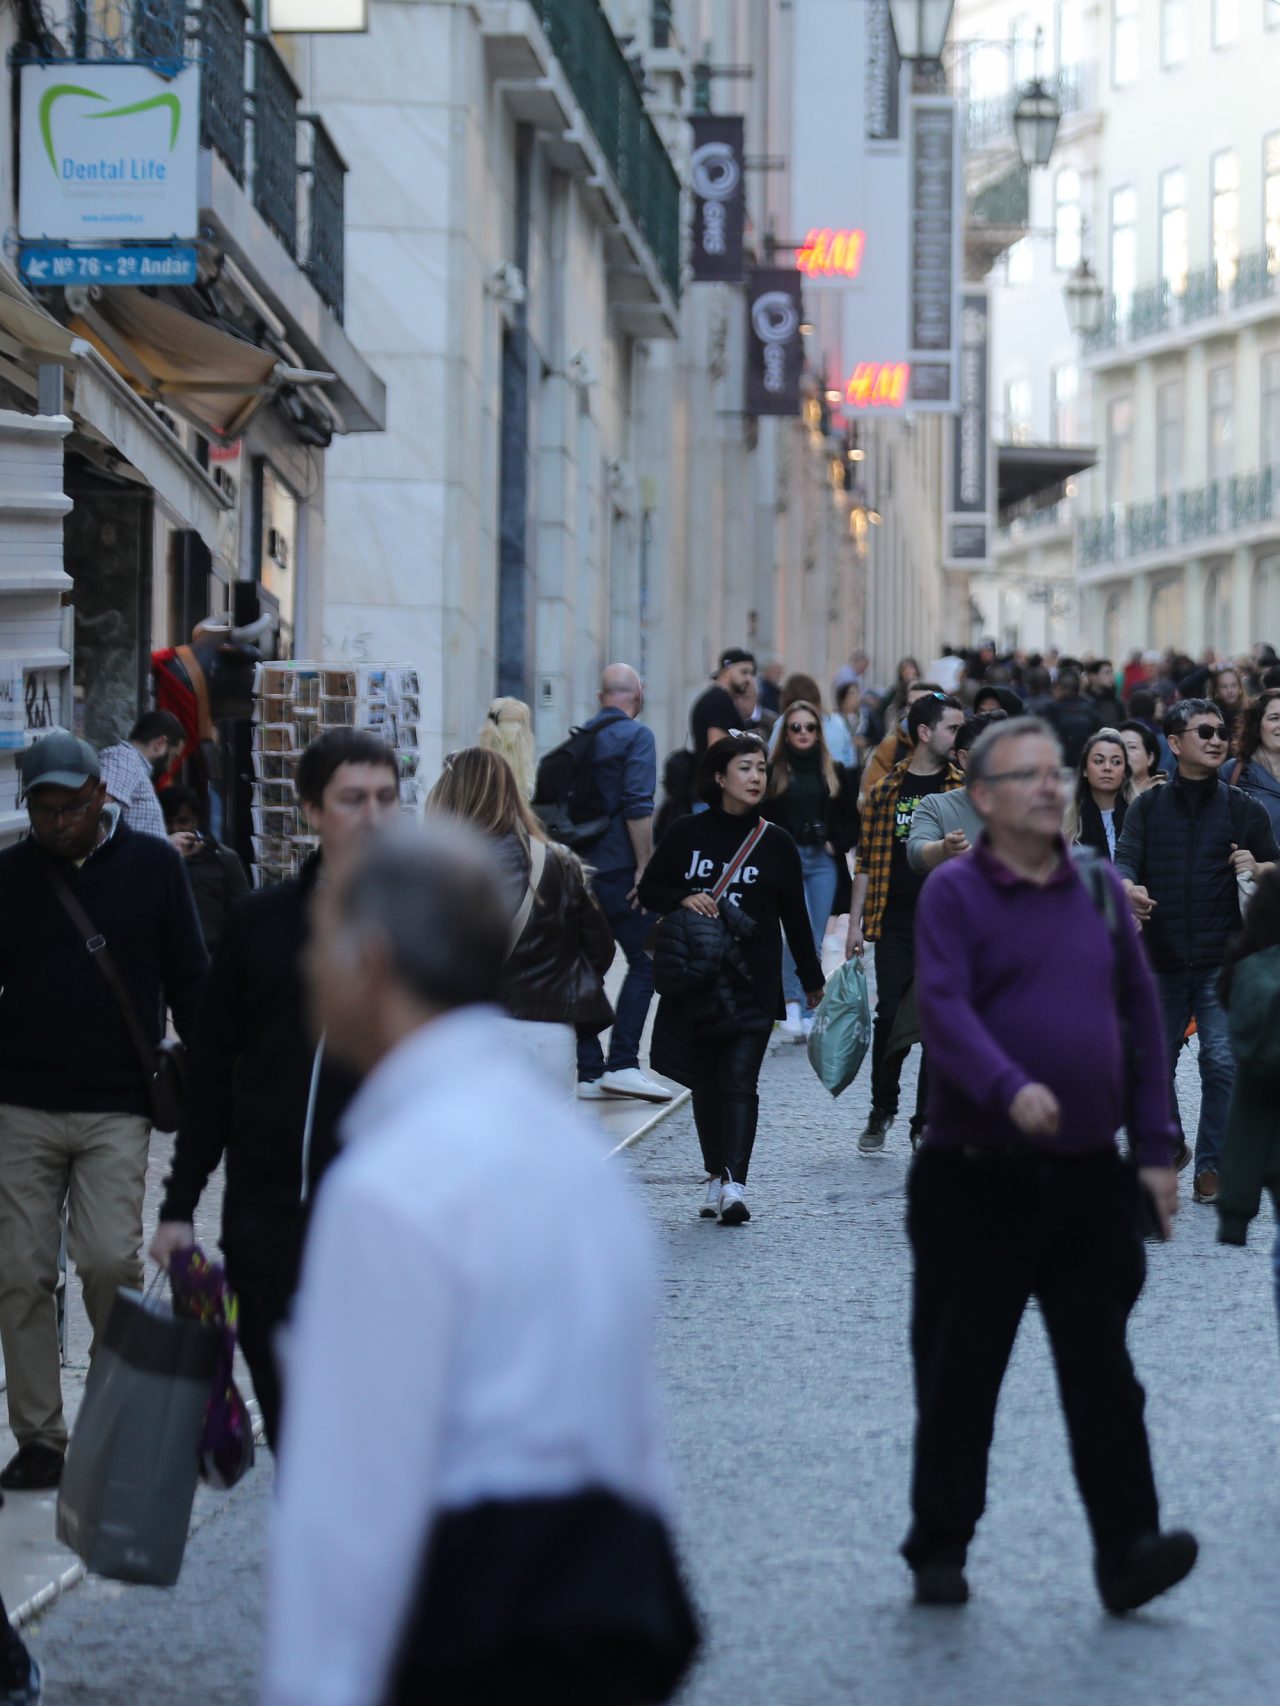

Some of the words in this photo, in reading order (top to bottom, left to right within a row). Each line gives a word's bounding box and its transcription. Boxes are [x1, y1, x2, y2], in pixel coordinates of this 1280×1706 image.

[62, 158, 125, 179] Dental
[131, 158, 167, 180] Life
[53, 257, 73, 275] Nº
[78, 257, 99, 275] 76
[117, 256, 137, 276] 2º
[141, 256, 191, 274] Andar
[684, 850, 714, 880] Je
